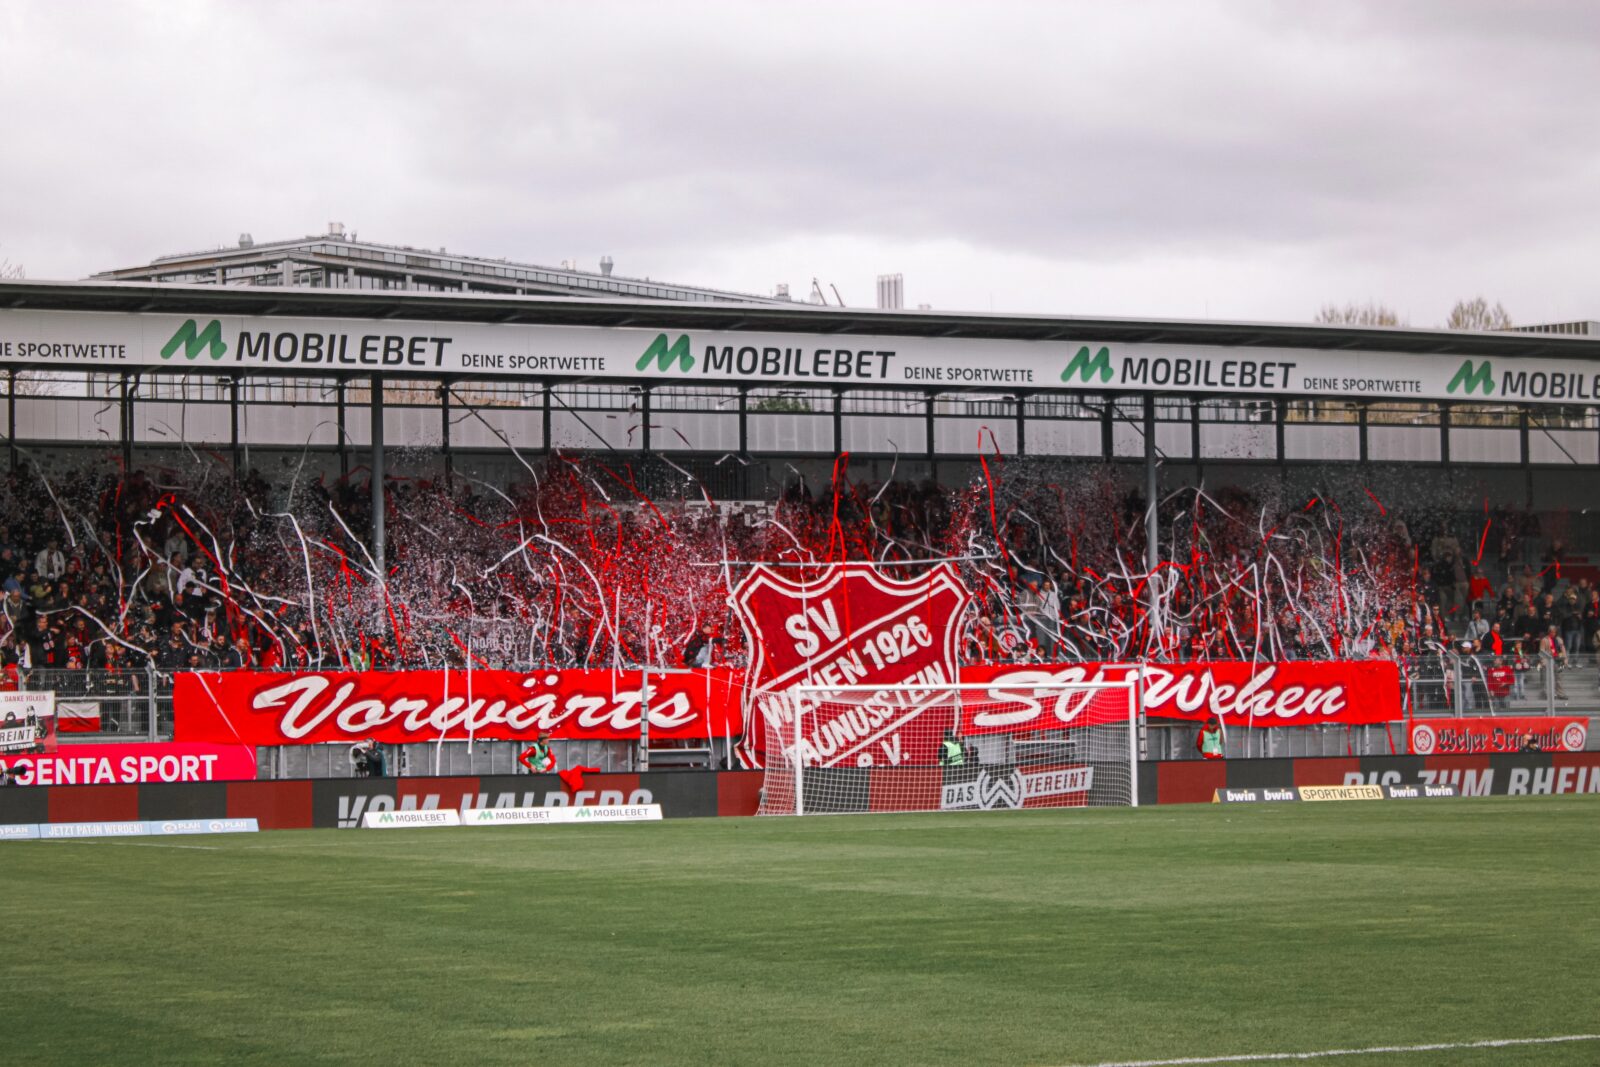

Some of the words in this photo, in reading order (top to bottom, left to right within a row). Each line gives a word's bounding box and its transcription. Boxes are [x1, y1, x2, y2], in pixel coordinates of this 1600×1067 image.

[18, 344, 126, 359] SPORTWETTE
[236, 331, 452, 367] MOBILEBET
[461, 354, 504, 368] DEINE
[509, 356, 605, 370] SPORTWETTE
[702, 345, 896, 379] MOBILEBET
[904, 366, 943, 380] DEINE
[946, 367, 1034, 382] SPORTWETTE
[1120, 357, 1297, 389] MOBILEBET
[1303, 378, 1339, 391] DEINE
[1342, 379, 1422, 393] SPORTWETTE
[785, 599, 841, 657] SV
[862, 615, 933, 670] 1926
[252, 674, 698, 739] Vorwärts
[120, 754, 218, 783] SPORT
[946, 785, 975, 804] DAS
[1026, 771, 1088, 793] VEREINT
[1264, 789, 1293, 801] bwin
[1303, 786, 1381, 800] SPORTWETTEN
[1390, 786, 1418, 798] bwin
[1425, 785, 1453, 797] bwin
[1226, 790, 1256, 802] bwin
[396, 813, 446, 823] MOBILEBET
[495, 810, 550, 820] MOBILEBET
[593, 808, 648, 817] MOBILEBET
[48, 824, 74, 836] JETZT
[105, 821, 144, 834] WERDEN!
